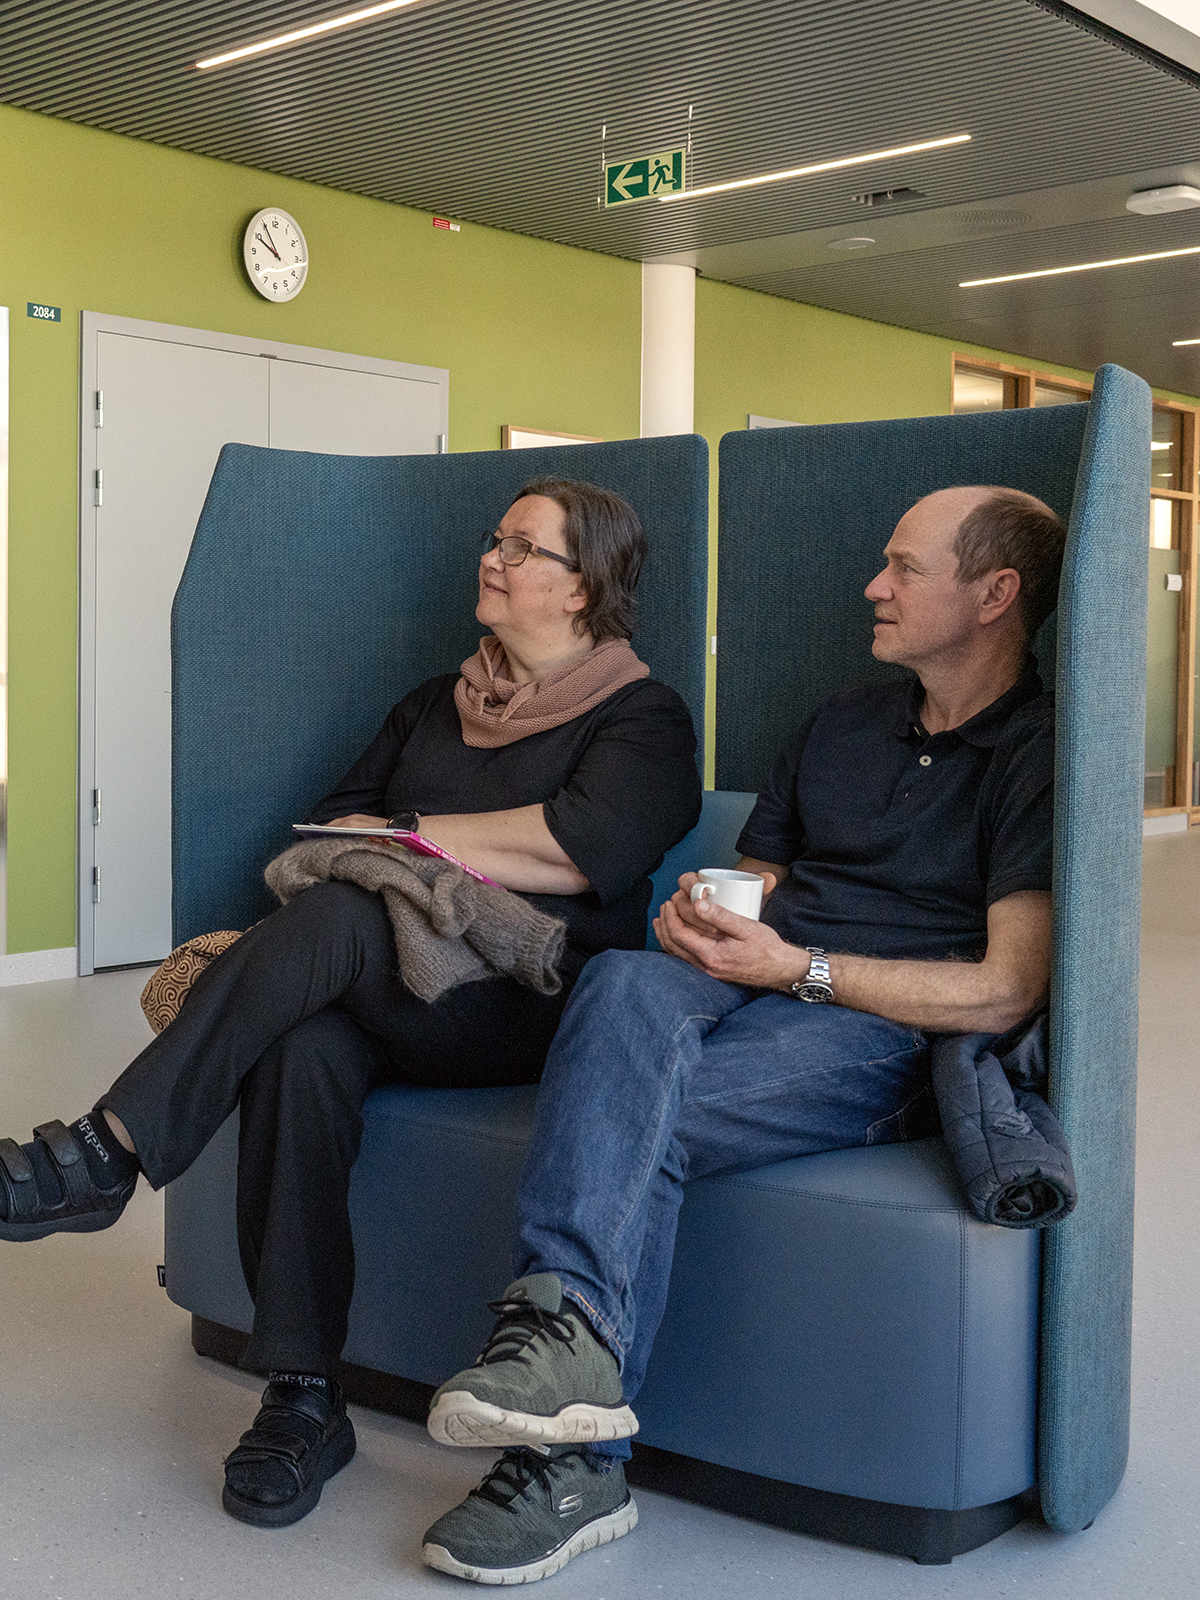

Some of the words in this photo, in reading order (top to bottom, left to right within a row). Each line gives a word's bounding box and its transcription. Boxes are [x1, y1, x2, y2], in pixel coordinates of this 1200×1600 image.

[272, 221, 279, 229] 12
[255, 263, 260, 271] 8
[32, 305, 55, 320] 2084
